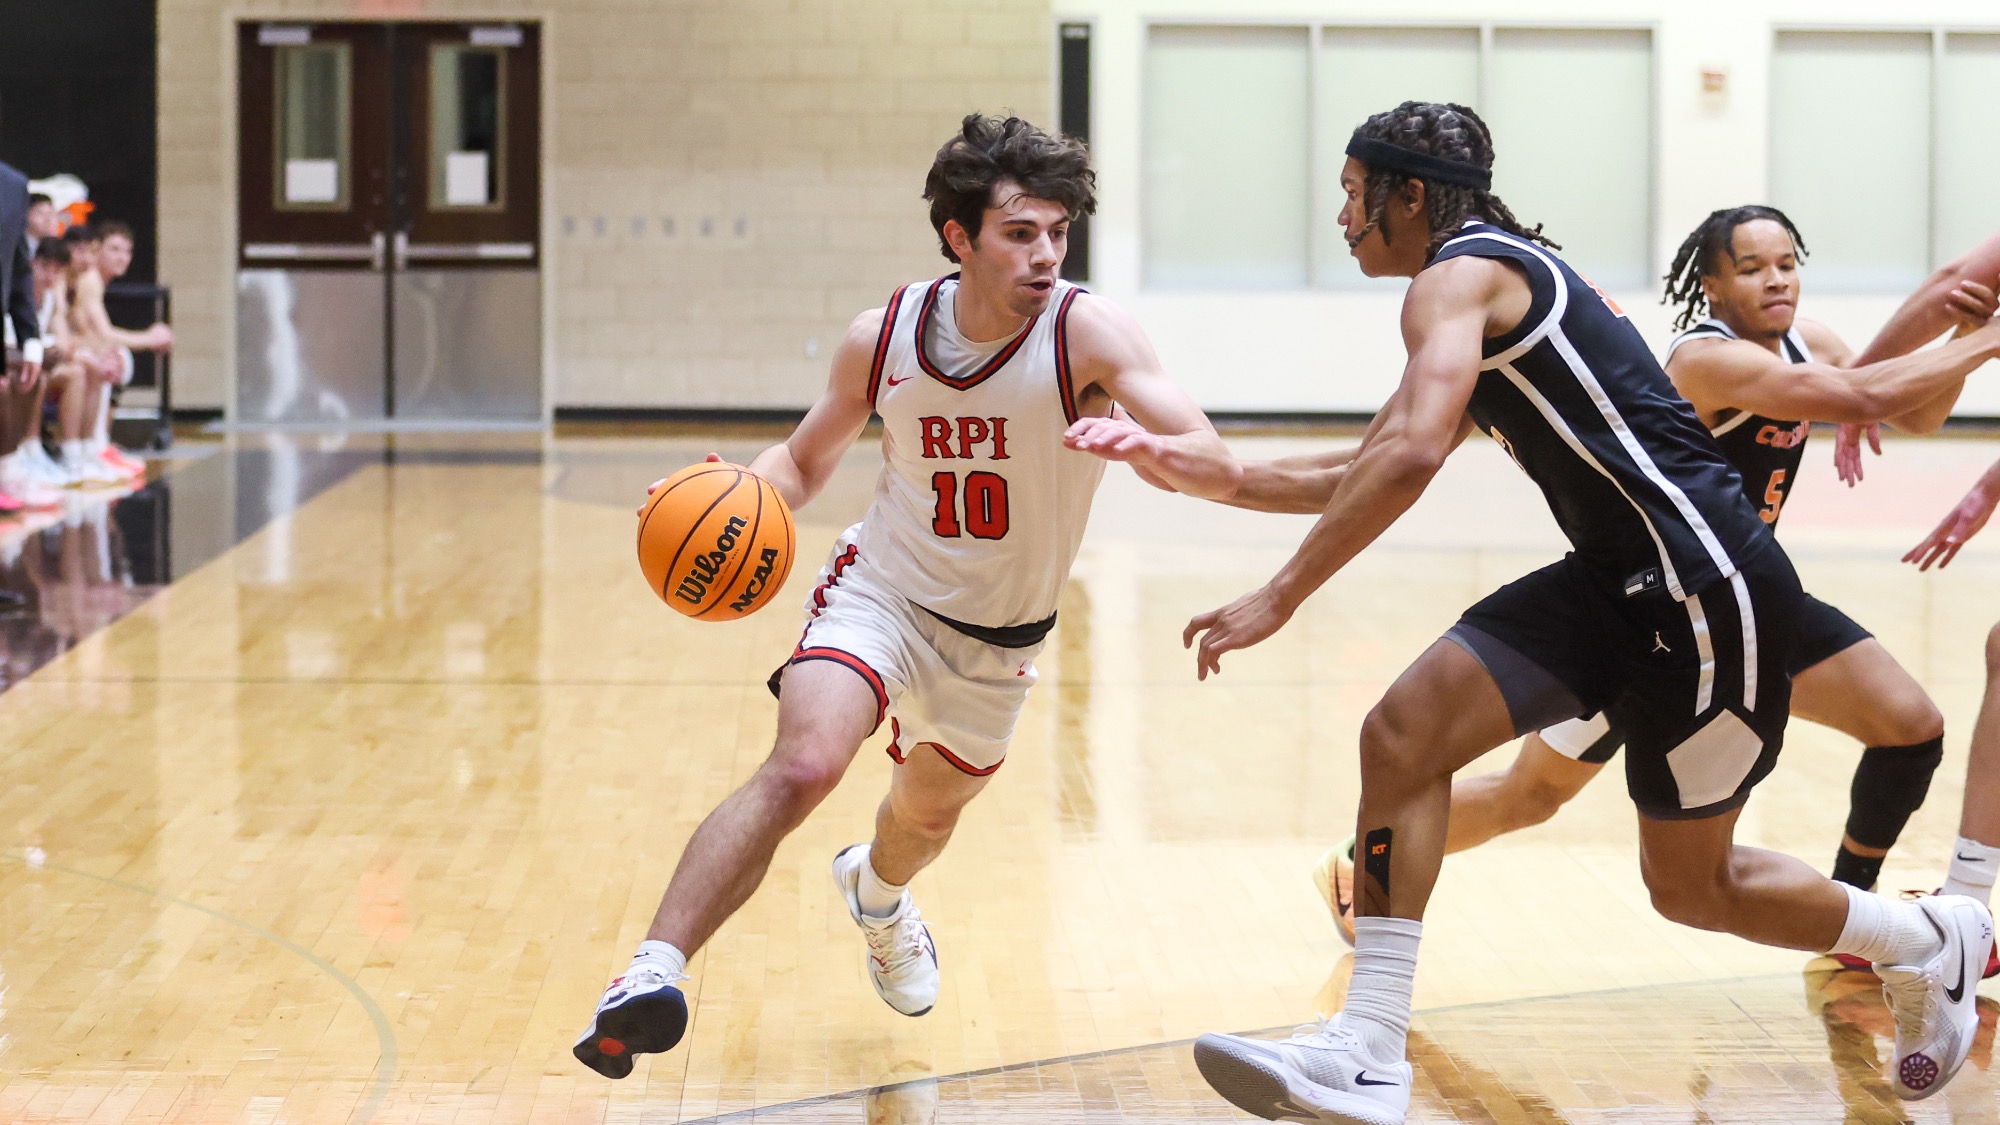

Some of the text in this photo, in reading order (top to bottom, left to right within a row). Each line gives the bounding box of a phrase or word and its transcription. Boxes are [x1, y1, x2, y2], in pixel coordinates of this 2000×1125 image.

[918, 416, 1011, 461] RPI
[932, 470, 1010, 540] 10
[1758, 469, 1786, 524] 5
[674, 515, 748, 605] Wilson
[729, 548, 779, 612] NCAA
[1646, 573, 1654, 584] M
